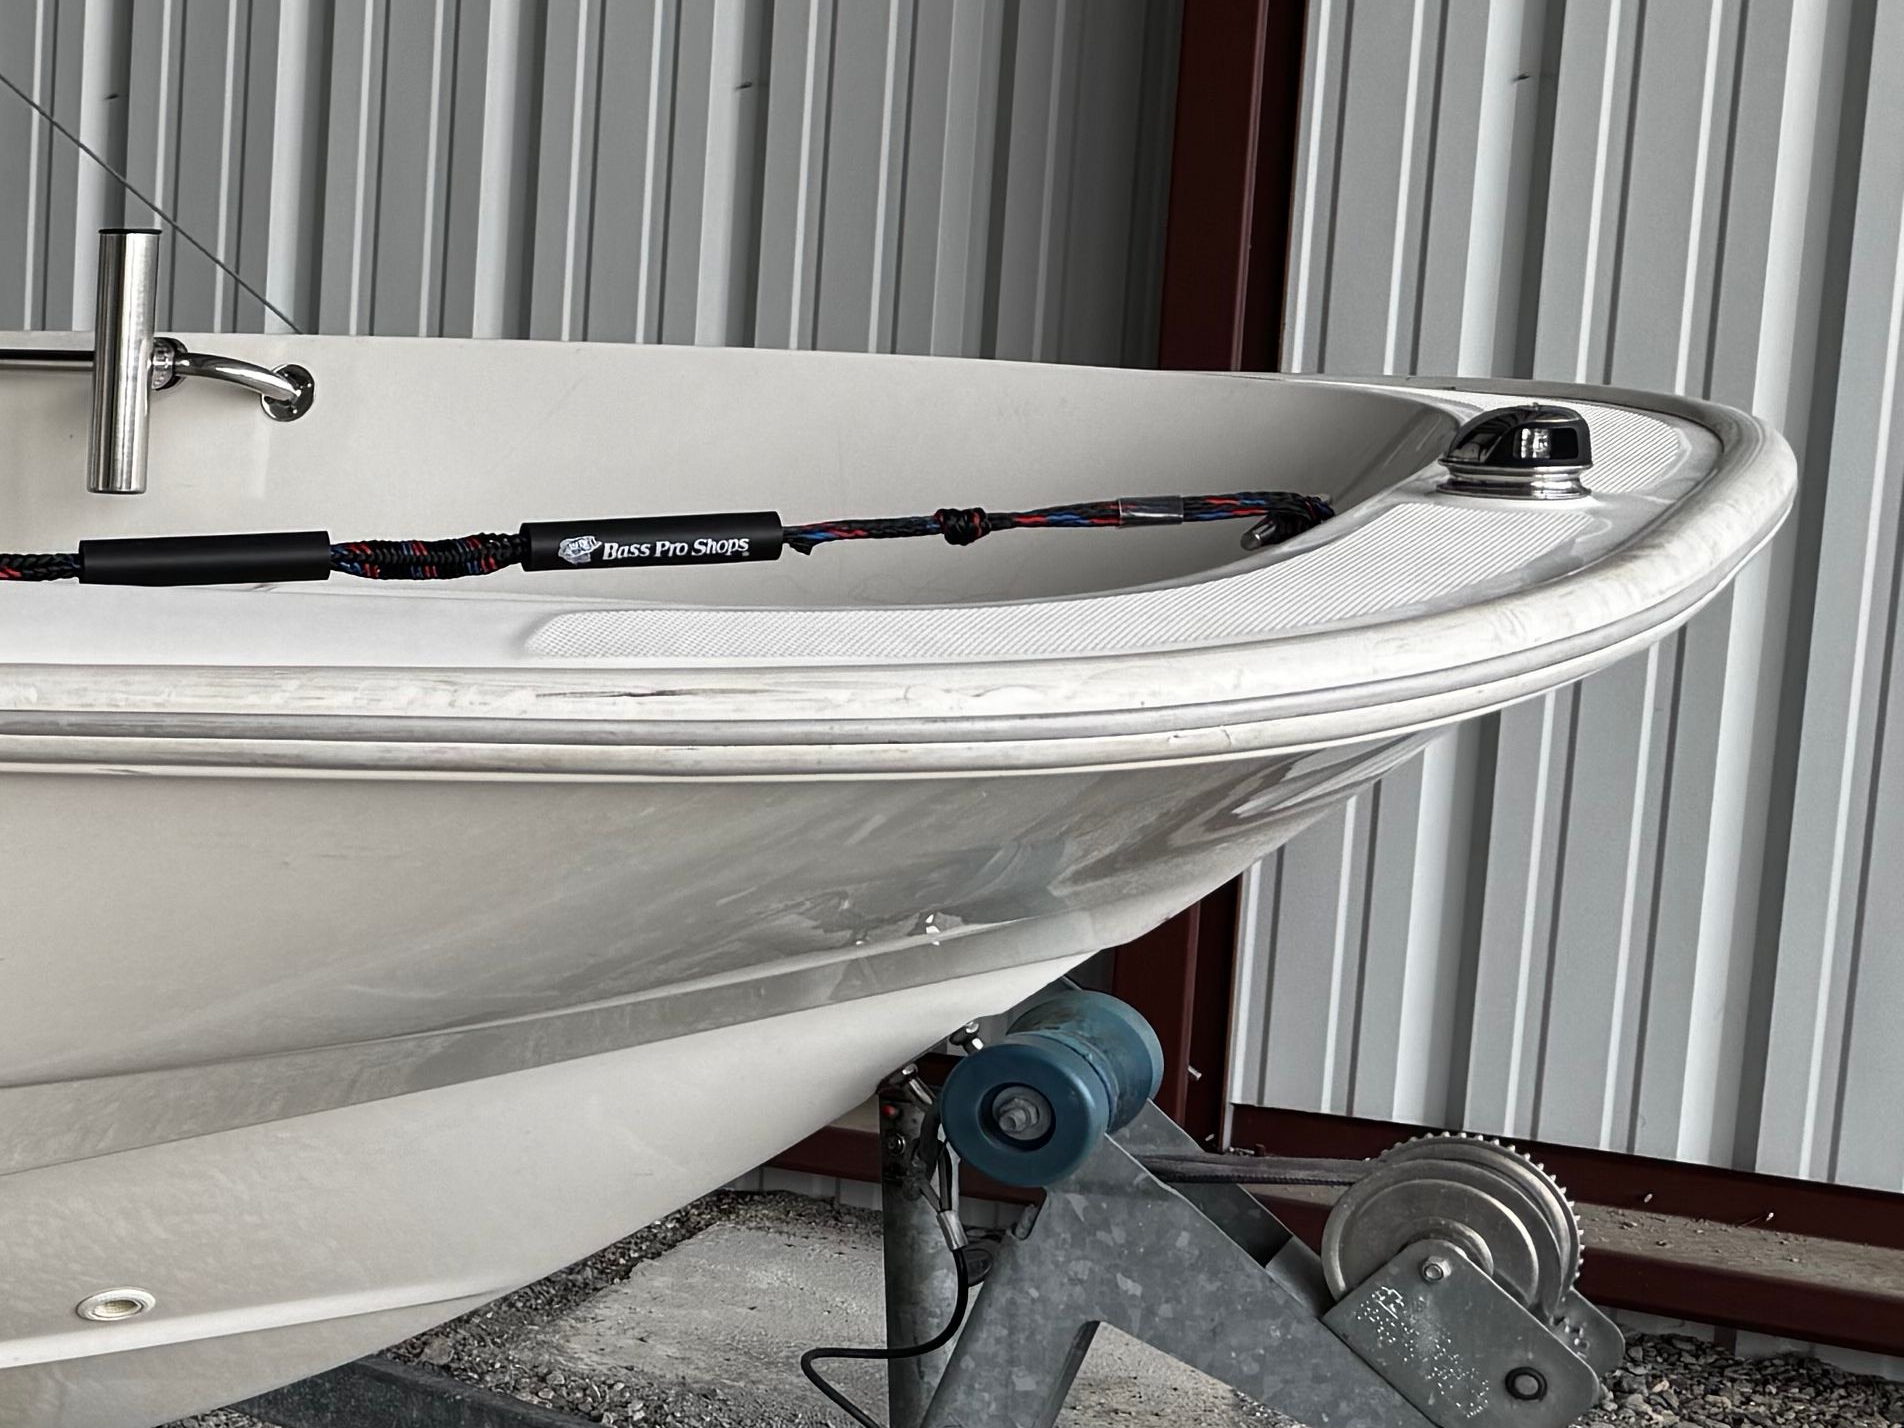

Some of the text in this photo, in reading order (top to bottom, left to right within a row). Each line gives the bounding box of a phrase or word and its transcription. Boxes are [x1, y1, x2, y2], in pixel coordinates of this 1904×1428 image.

[602, 537, 750, 560] Bass Pro Shops
